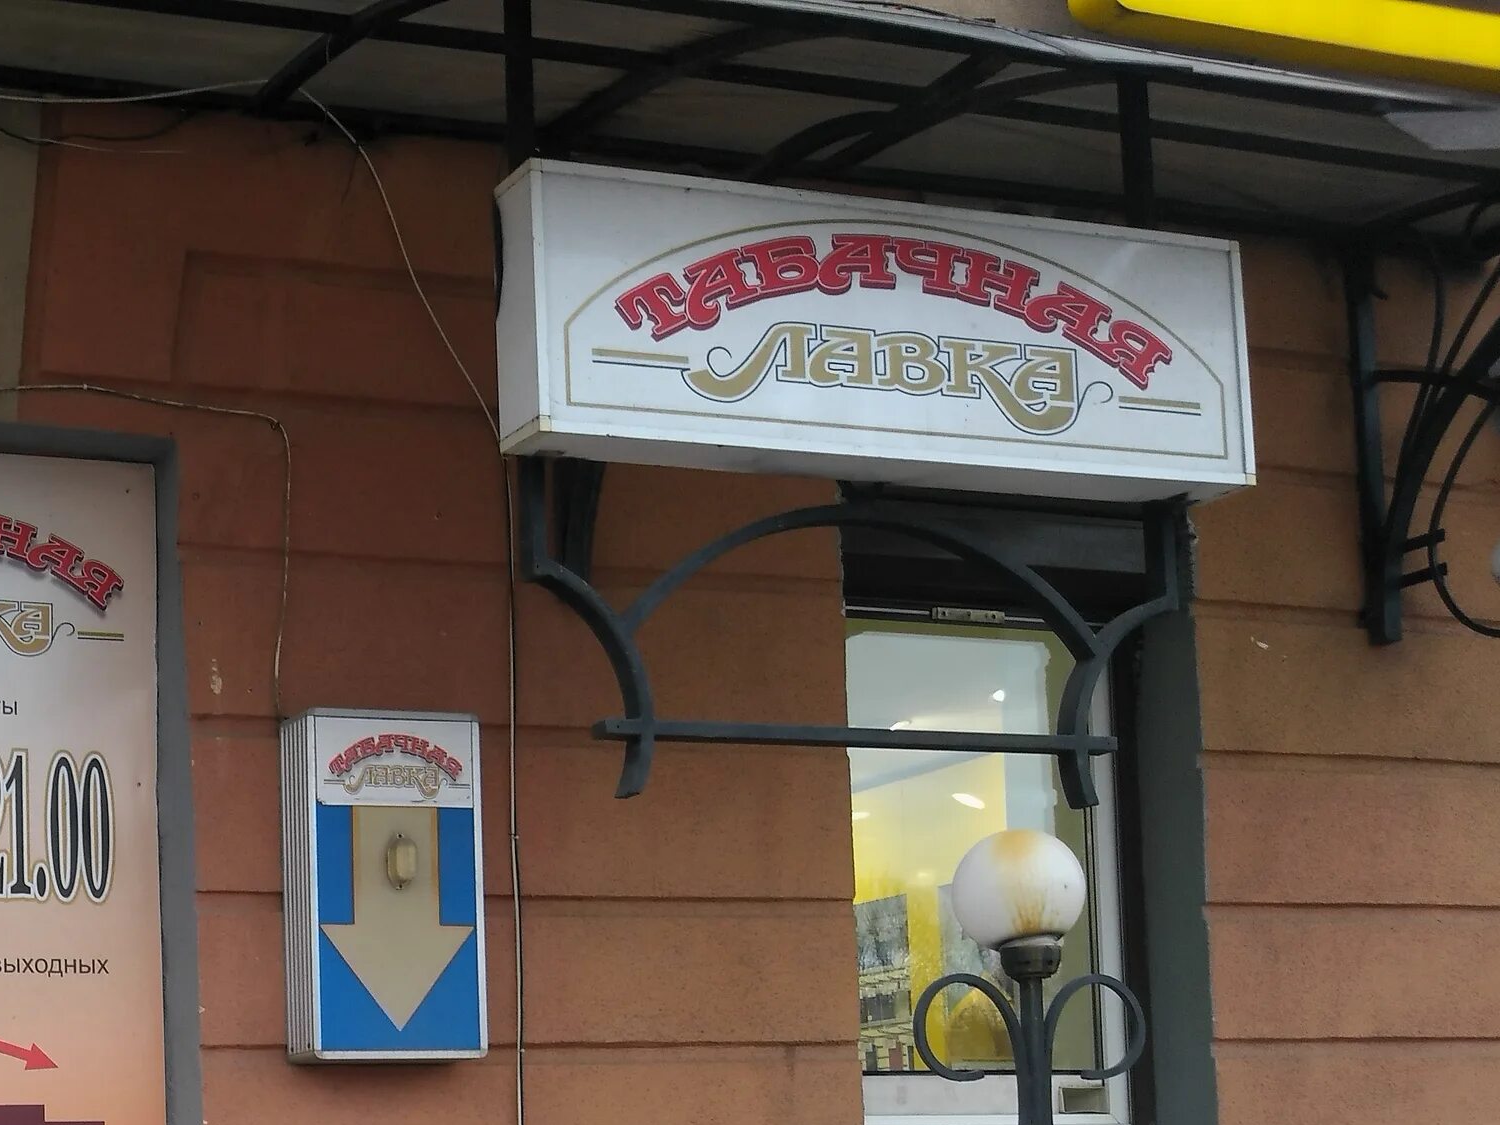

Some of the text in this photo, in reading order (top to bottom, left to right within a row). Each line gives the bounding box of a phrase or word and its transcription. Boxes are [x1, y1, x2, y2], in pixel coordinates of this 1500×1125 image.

[614, 233, 1173, 390] ТАБАЧНАЯ
[682, 320, 1114, 436] ЛАВКА
[328, 733, 463, 781] ТАБАЧНАЯ
[344, 764, 448, 799] ЛАВКА
